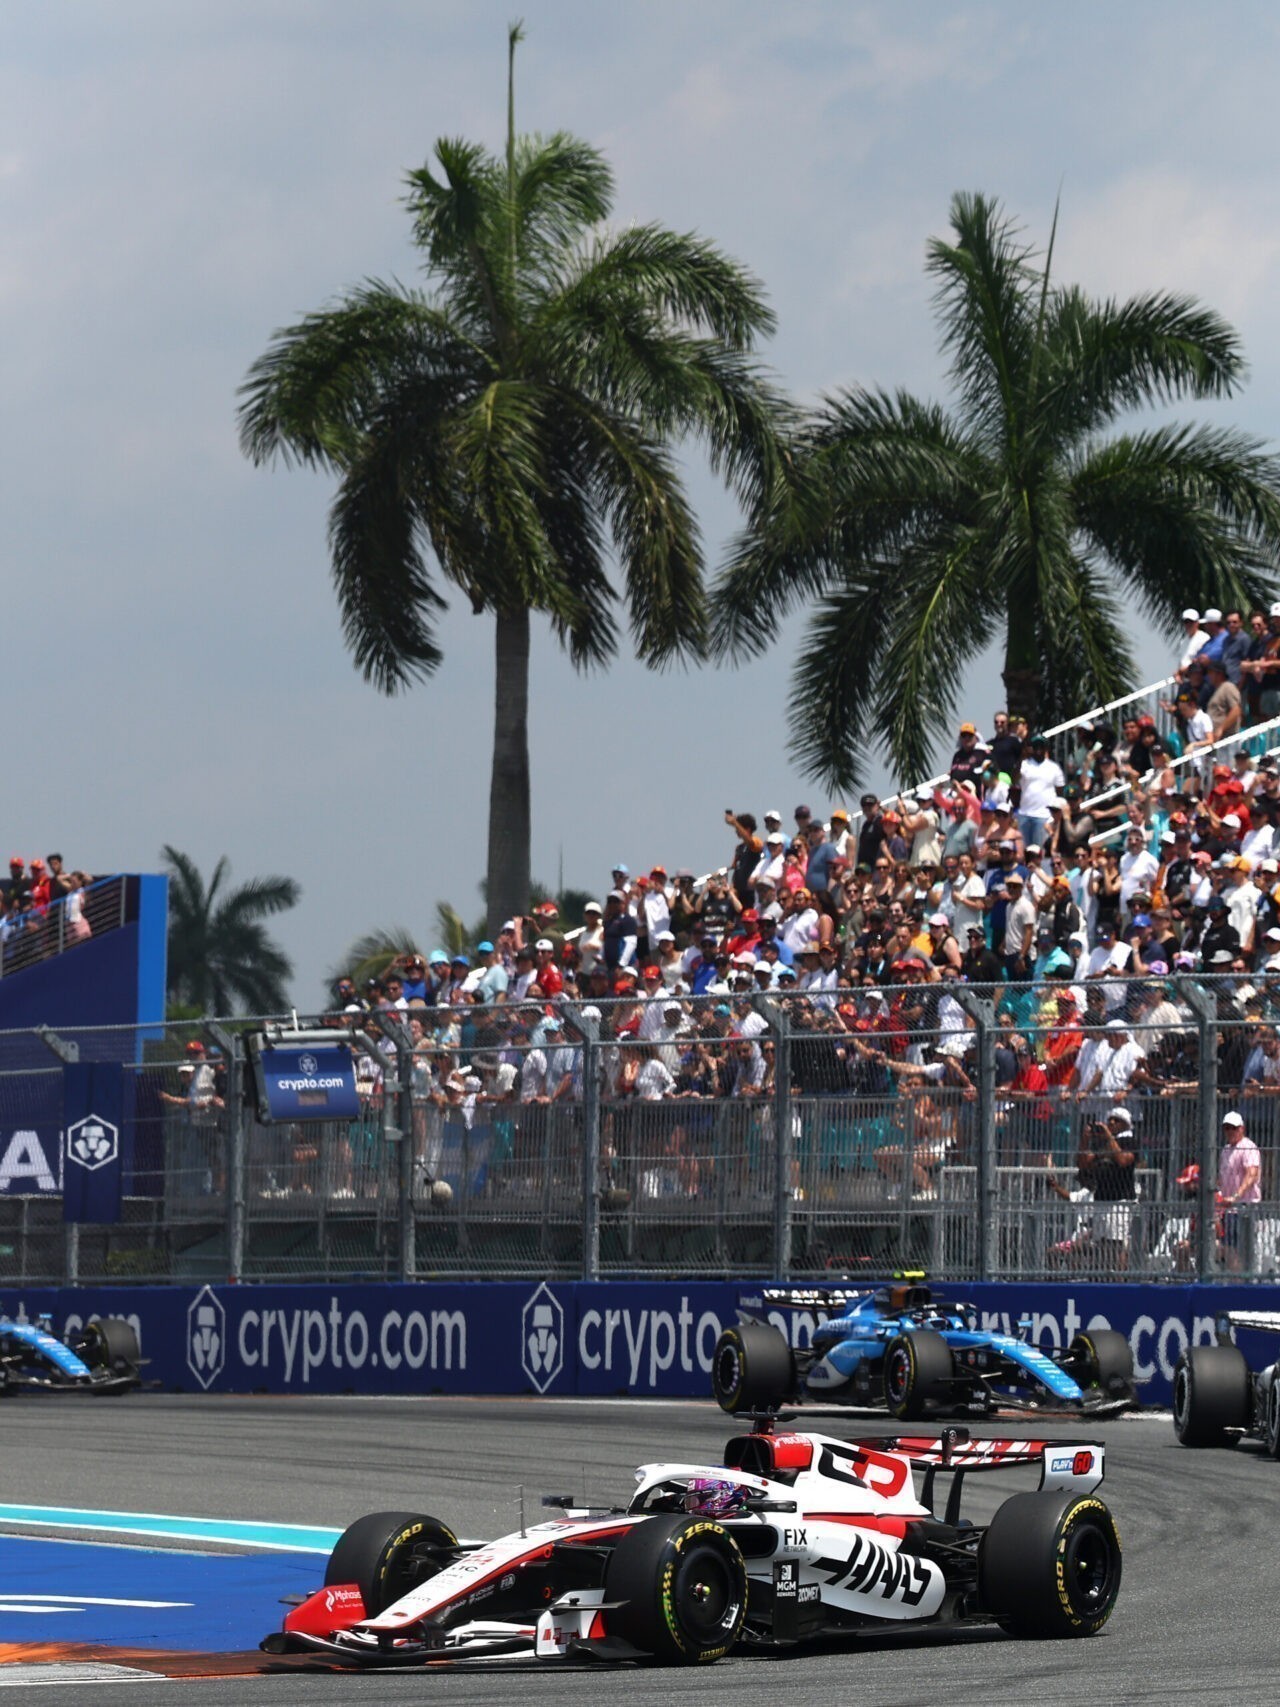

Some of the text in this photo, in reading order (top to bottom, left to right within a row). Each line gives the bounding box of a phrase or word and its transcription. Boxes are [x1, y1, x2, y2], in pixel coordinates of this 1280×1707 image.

[278, 1077, 343, 1091] crypto.com
[0, 1130, 64, 1190] A
[239, 1297, 466, 1382] crypto.com
[1073, 1451, 1092, 1475] GO
[685, 1522, 724, 1540] ZERO
[784, 1528, 808, 1546] FIX
[776, 1581, 797, 1591] MGM
